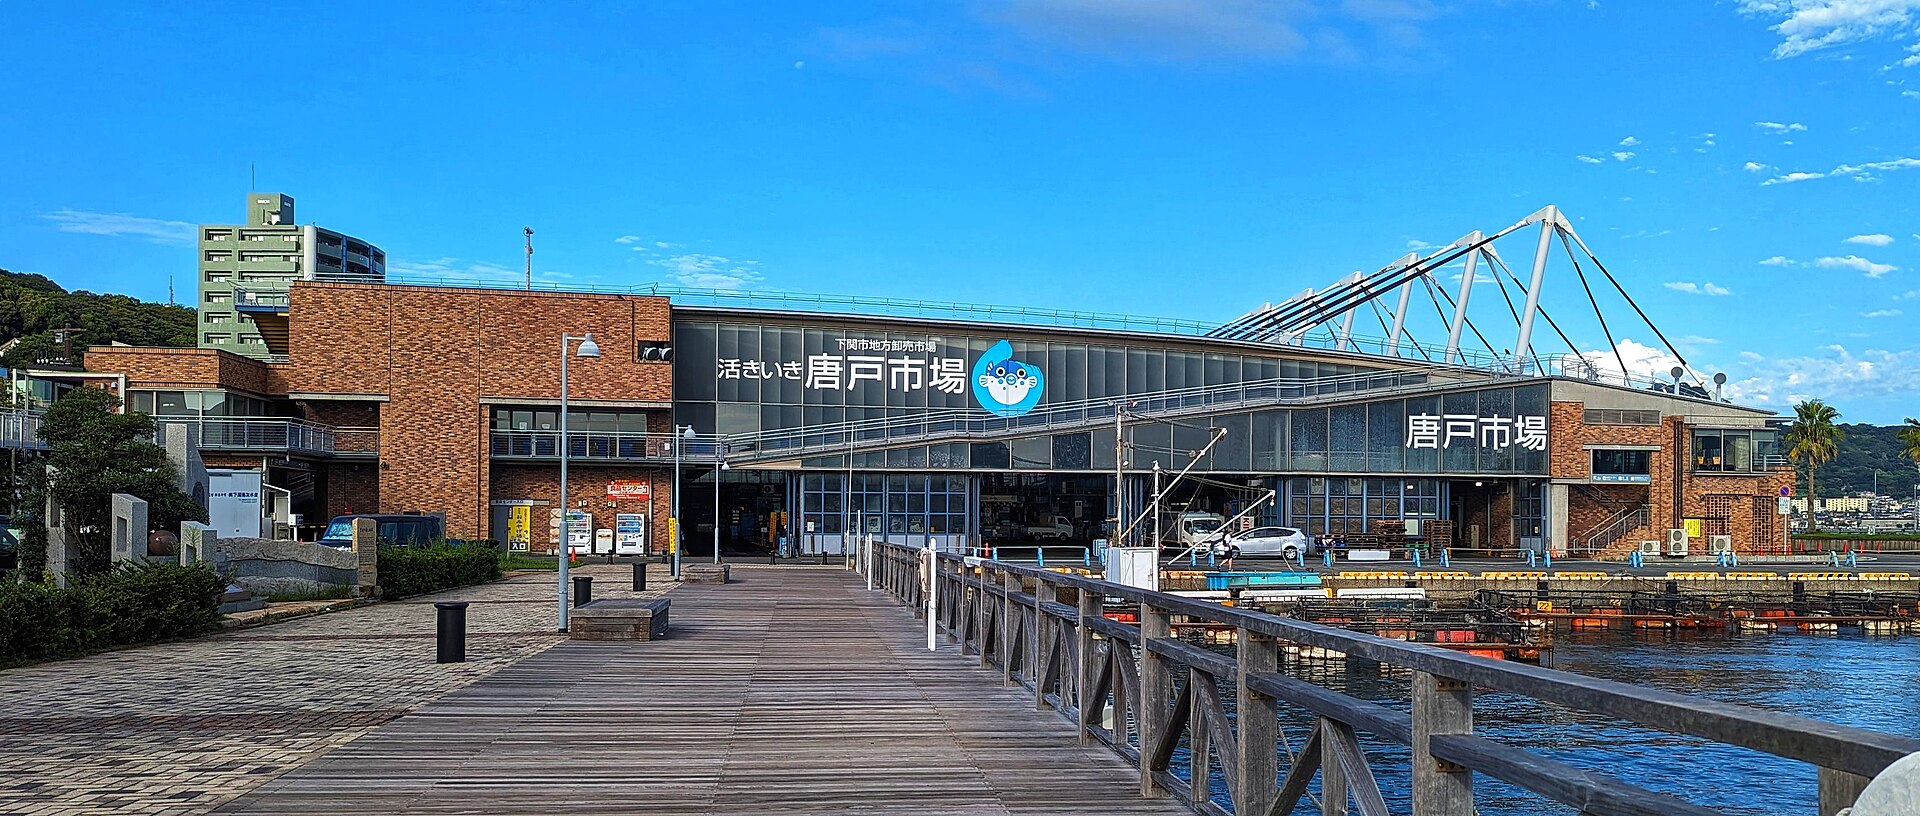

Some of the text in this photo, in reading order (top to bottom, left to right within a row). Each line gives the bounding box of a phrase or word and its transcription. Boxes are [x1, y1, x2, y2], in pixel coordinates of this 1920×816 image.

[835, 338, 936, 353] 下関市地方卸売市場
[717, 353, 966, 394] 活きいき 唐戸市場
[1405, 412, 1548, 451] 唐戸市場
[512, 542, 526, 550] 入口
